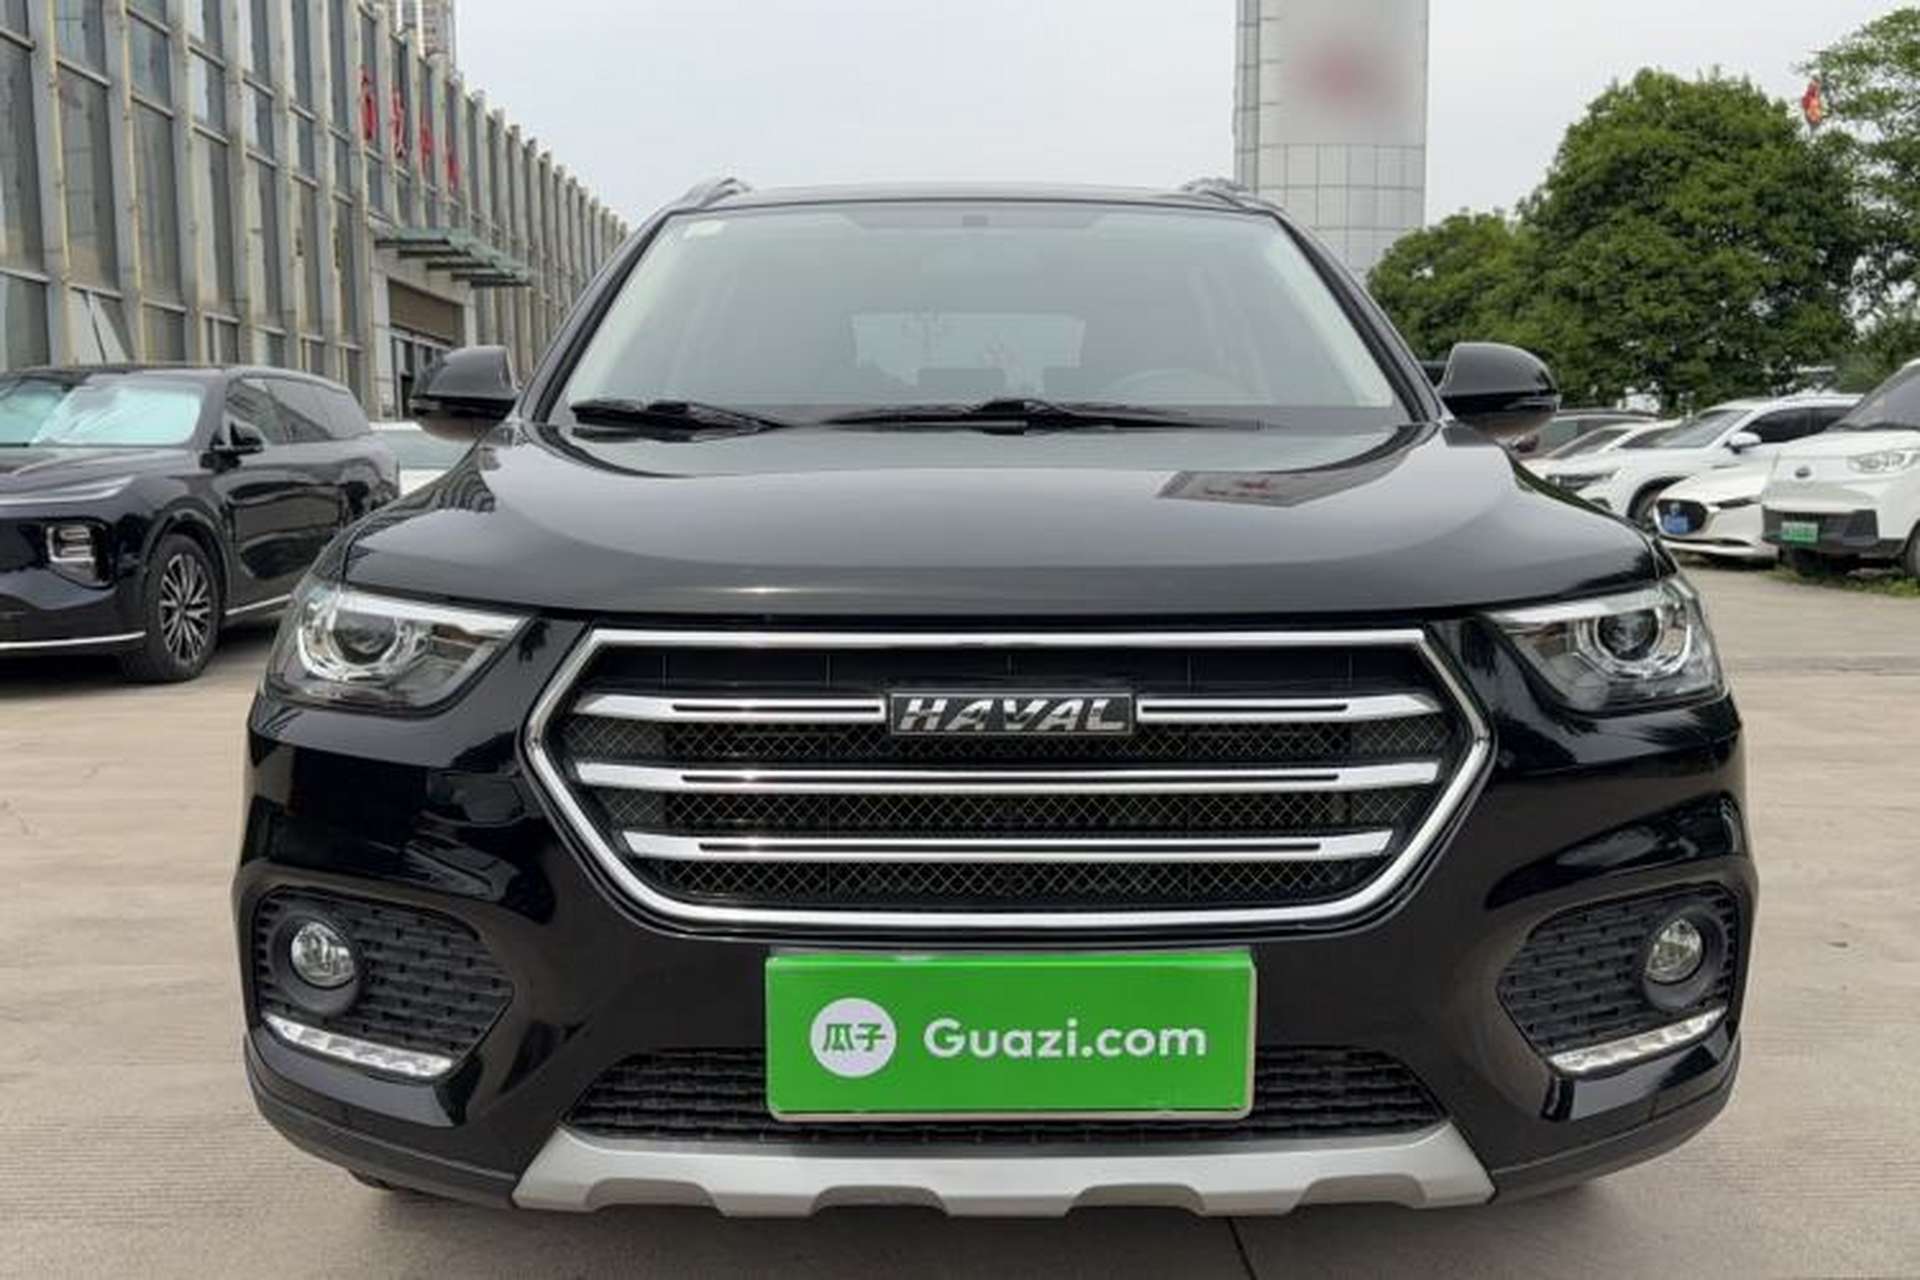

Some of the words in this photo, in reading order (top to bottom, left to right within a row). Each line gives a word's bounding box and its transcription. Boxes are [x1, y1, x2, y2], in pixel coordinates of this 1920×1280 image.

[899, 698, 1126, 731] HAVAL
[823, 1023, 887, 1053] 瓜子
[923, 1018, 1207, 1058] Guazi.com
